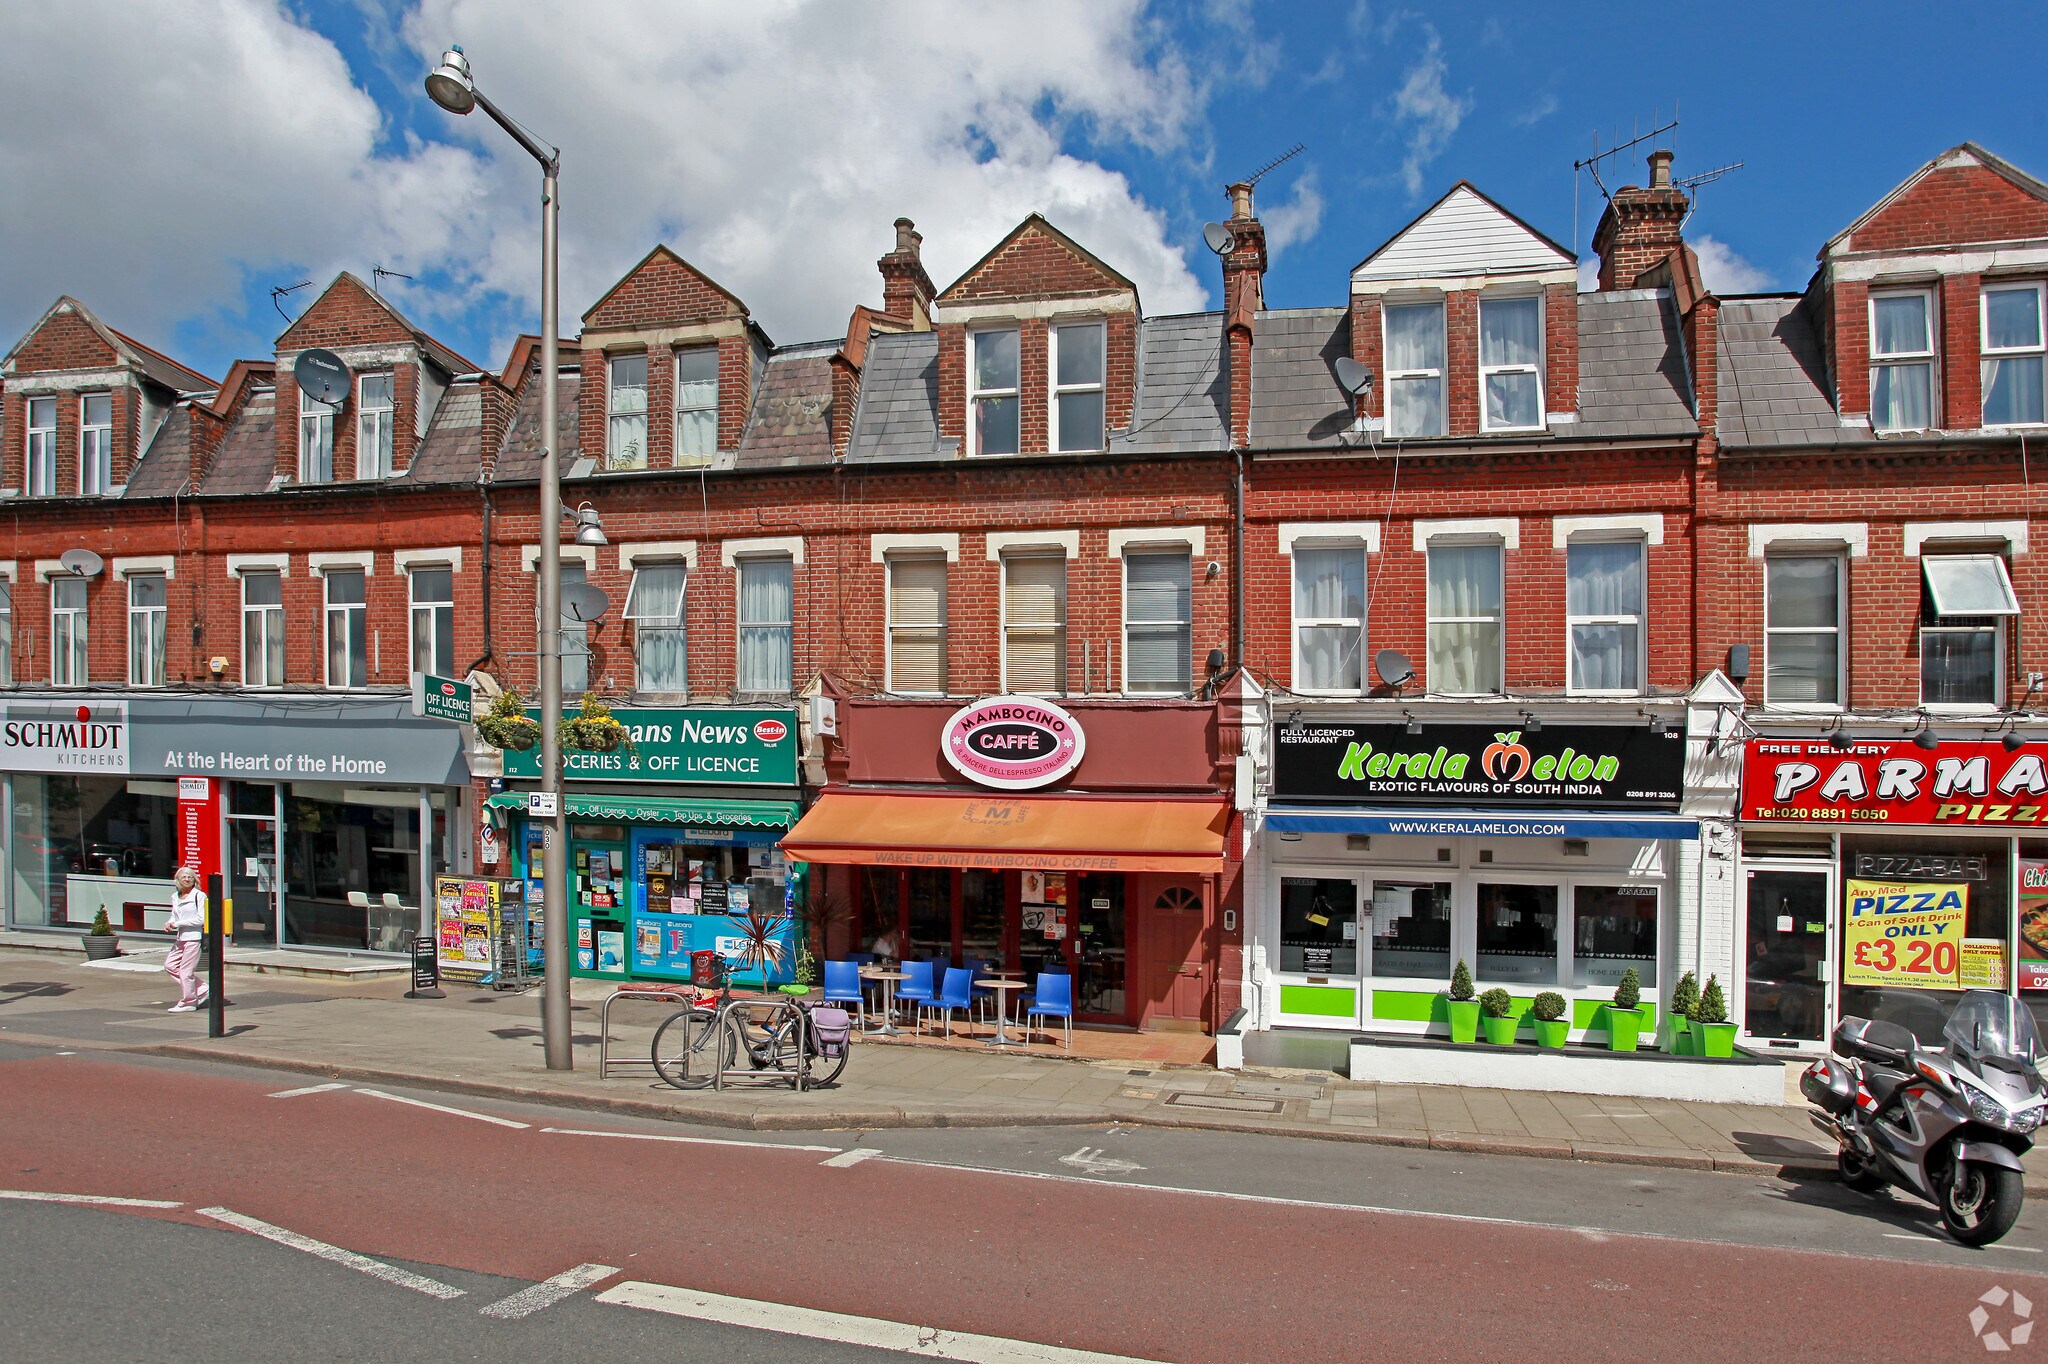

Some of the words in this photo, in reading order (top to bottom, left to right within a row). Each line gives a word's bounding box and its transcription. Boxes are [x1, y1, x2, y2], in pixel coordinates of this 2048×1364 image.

[427, 693, 440, 705] OFF
[442, 697, 470, 712] LICENCE
[456, 712, 468, 720] LATE
[960, 708, 1065, 732] MAMBOCINO
[4, 706, 123, 749] SCHMIDT
[680, 719, 748, 744] News
[980, 732, 1040, 750] CAFFÉ
[1760, 745, 1801, 753] FREE
[1807, 745, 1891, 754] DELIVERY
[58, 754, 124, 766] KITCHENS
[164, 750, 183, 768] At
[188, 751, 215, 768] the
[220, 752, 269, 770] Heart
[274, 754, 293, 771] of
[297, 755, 326, 772] the
[332, 755, 386, 774] Home
[629, 756, 640, 770] &
[648, 756, 680, 770] OFF
[688, 757, 759, 773] LICENCE
[961, 754, 988, 772] PIACERE
[988, 766, 1042, 776] DELL'ESPRESSO
[1044, 751, 1068, 772] ITALIANO
[1338, 742, 1470, 780] Kerala
[1482, 736, 1619, 781] Melon
[1370, 782, 1417, 792] EXOTIC
[1420, 782, 1489, 793] FLAVOURS
[1493, 783, 1510, 793] OF
[1514, 784, 1560, 794] SOUTH
[1565, 784, 1602, 795] INDIA
[600, 807, 626, 815] Licence
[637, 809, 660, 818] Oyster
[674, 811, 686, 820] Top
[689, 812, 702, 820] Ups
[716, 813, 752, 821] Groceries
[985, 807, 1011, 818] M
[1812, 808, 1846, 819] 8891
[1851, 809, 1888, 820] 5050
[1936, 804, 2048, 821] PIZZ
[1389, 822, 1565, 835] WWW.KERALAMELON.COM
[876, 852, 912, 864] WAKE
[917, 854, 934, 864] UP
[937, 854, 969, 865] WITH
[974, 856, 1058, 867] MAMBOCINO
[1062, 858, 1118, 869] COFFEE
[1932, 859, 1980, 878] BAR
[1850, 888, 1876, 897] Any
[1878, 886, 1906, 895] Med
[1852, 890, 1962, 917] PIZZA
[1884, 918, 1897, 926] of
[1899, 916, 1925, 924] Soft
[1928, 913, 1962, 922] Drink
[1885, 923, 1949, 938] ONLY
[1854, 939, 1956, 975] £3.20
